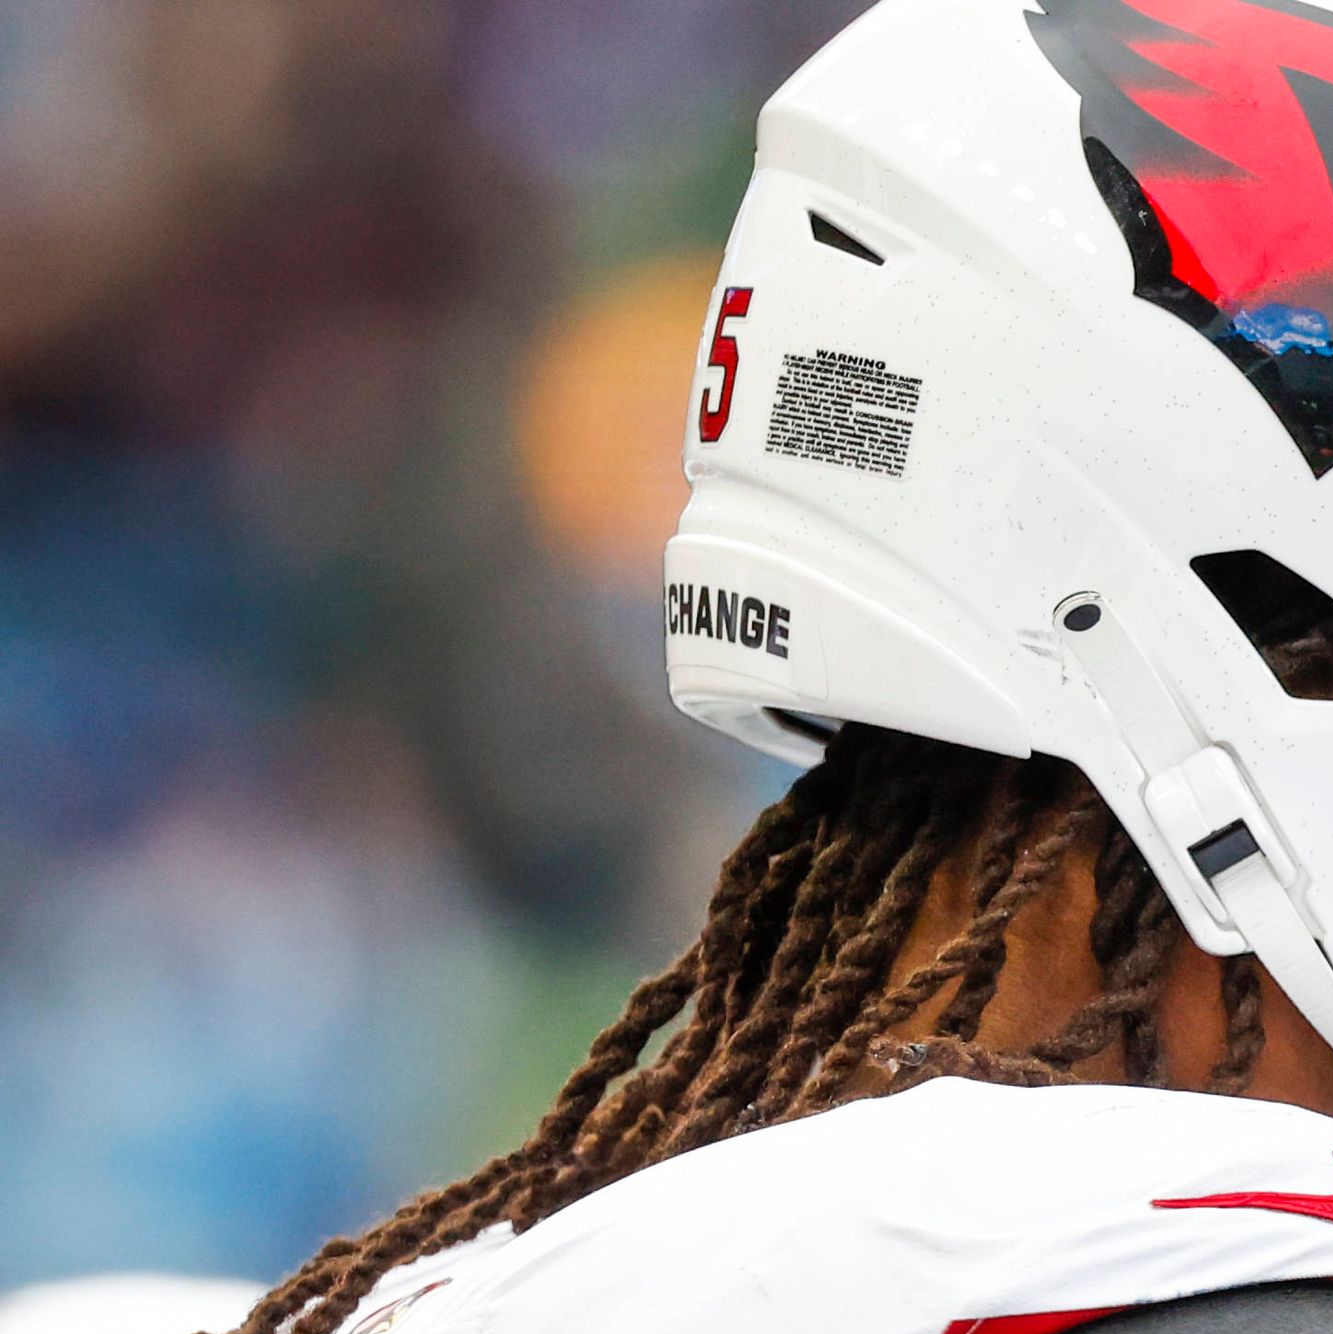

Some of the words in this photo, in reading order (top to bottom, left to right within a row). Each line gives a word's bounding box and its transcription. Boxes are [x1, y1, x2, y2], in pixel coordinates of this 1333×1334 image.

[700, 286, 754, 443] 5
[816, 349, 886, 370] WARNING
[668, 583, 791, 659] CHANGE
